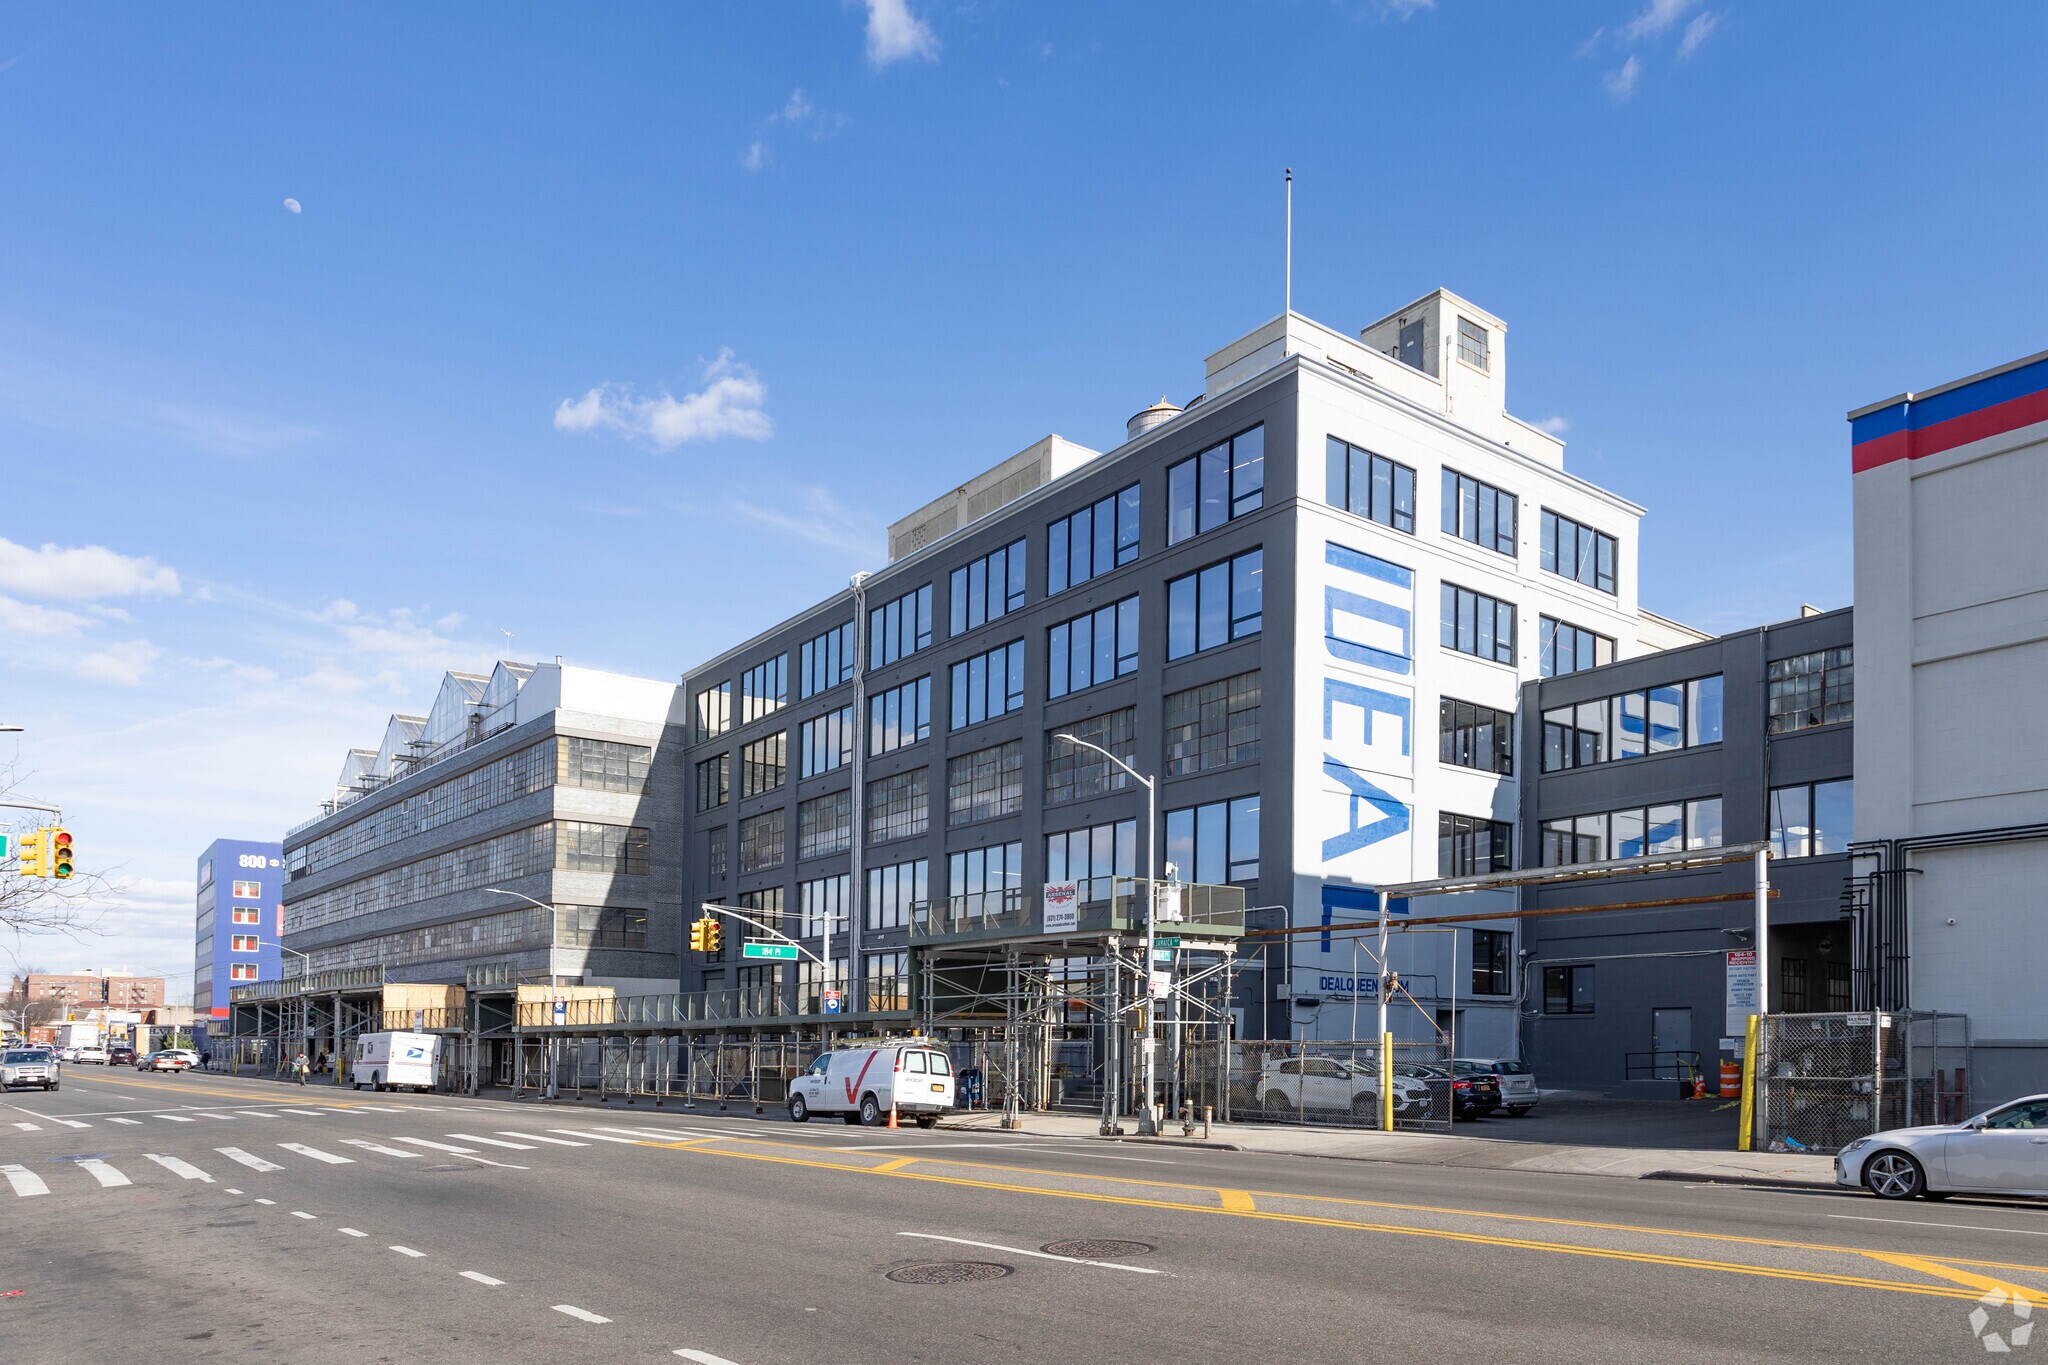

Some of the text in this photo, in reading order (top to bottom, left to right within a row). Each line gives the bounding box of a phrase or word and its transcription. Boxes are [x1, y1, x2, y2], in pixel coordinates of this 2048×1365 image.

[1322, 540, 1412, 953] IDEAL
[239, 854, 267, 869] 800
[1048, 890, 1074, 898] ARSENAL
[1155, 938, 1173, 947] JAMAICA
[762, 947, 773, 956] 184
